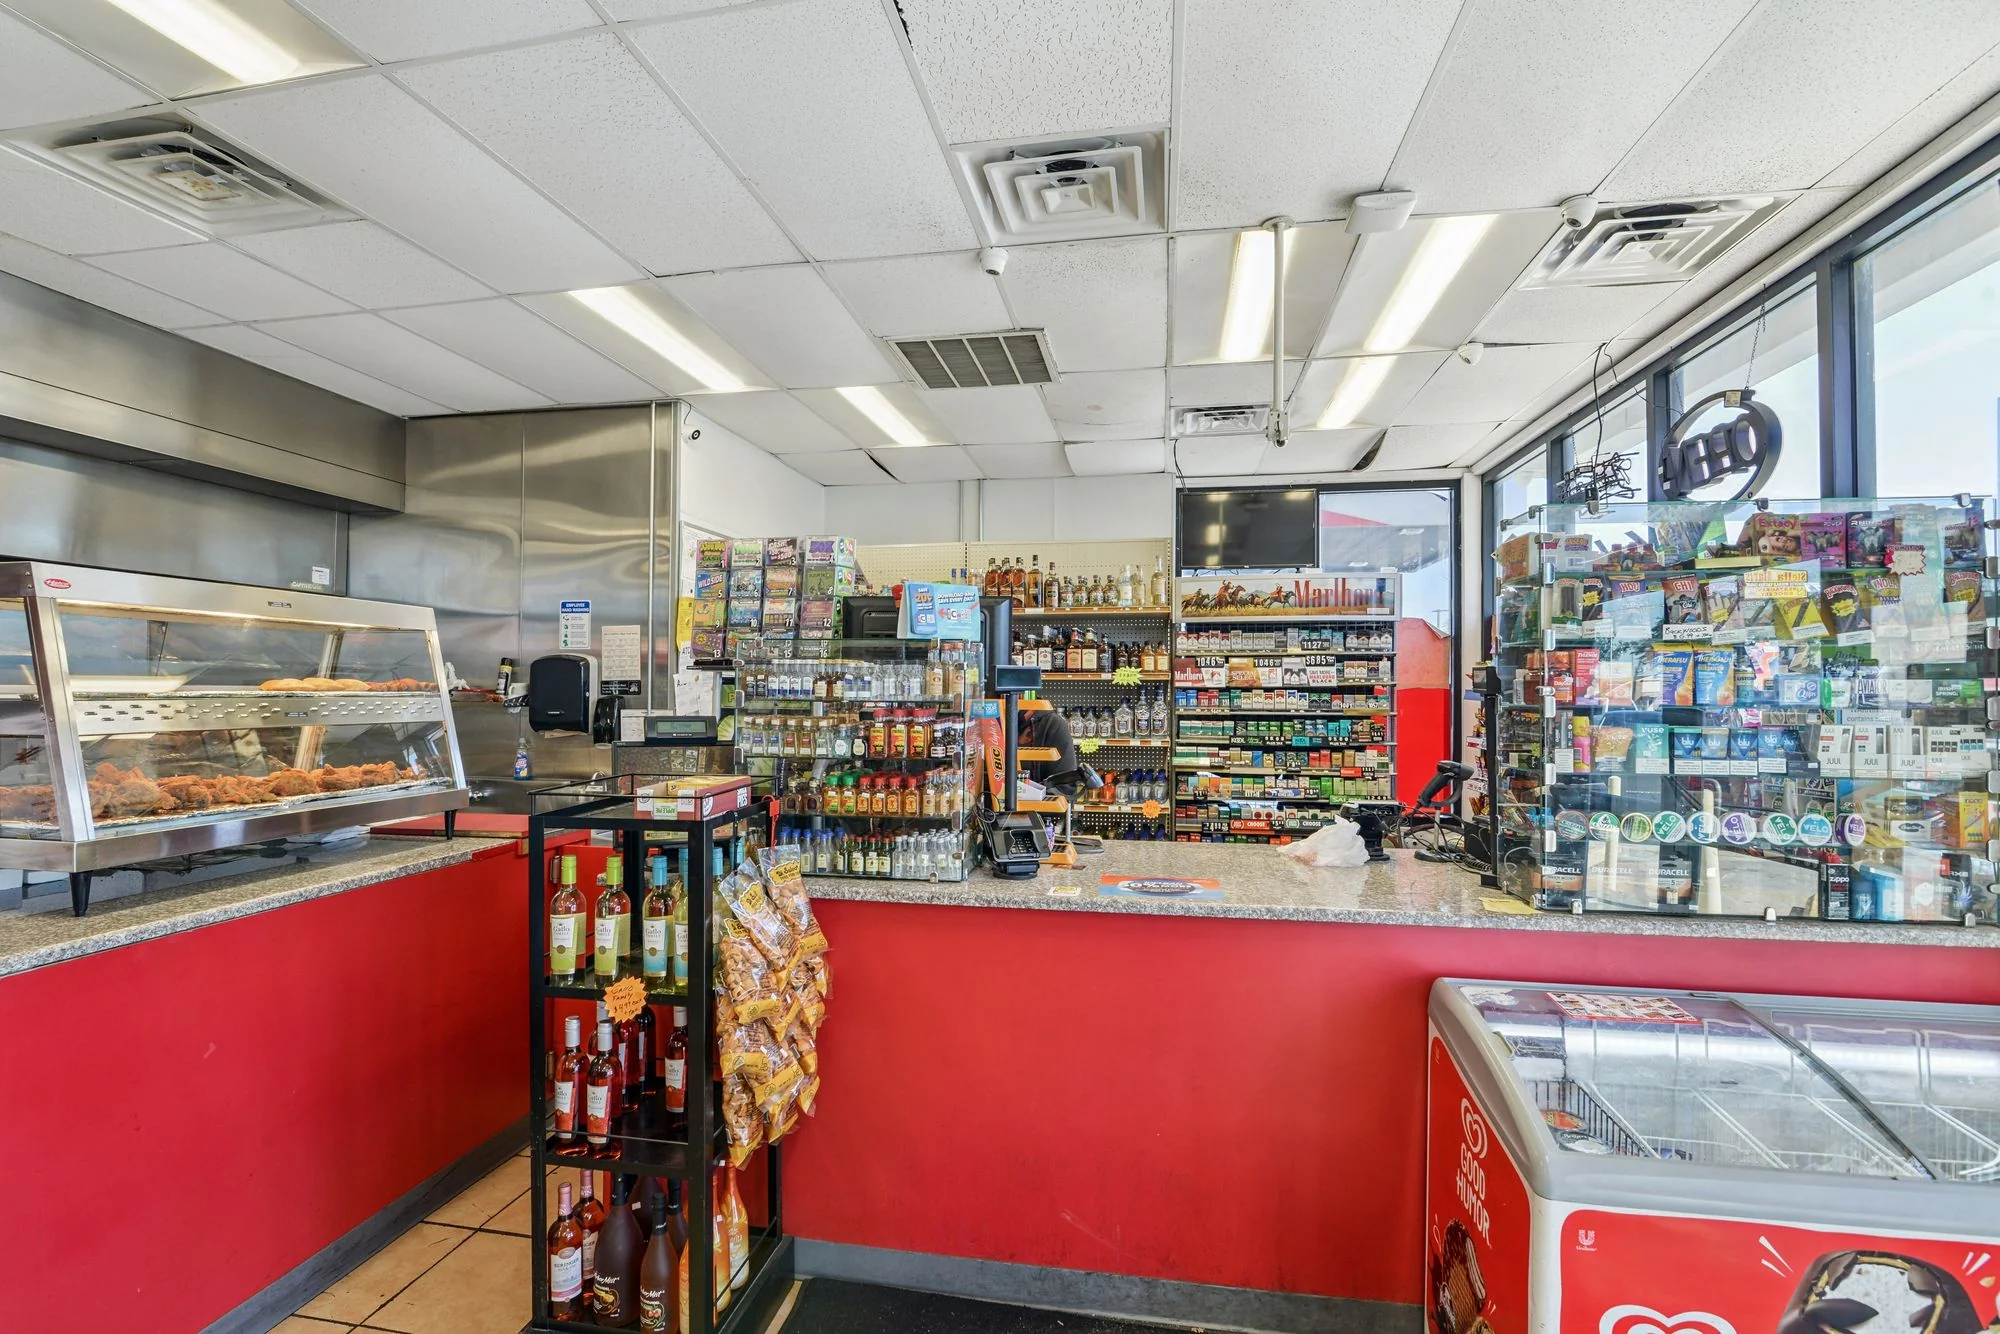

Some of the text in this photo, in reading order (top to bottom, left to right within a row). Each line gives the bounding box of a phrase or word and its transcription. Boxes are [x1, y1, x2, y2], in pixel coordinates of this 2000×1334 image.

[1759, 519, 1797, 529] Extacy
[1174, 667, 1203, 681] Marlboro
[1641, 726, 1665, 734] vuse
[1681, 734, 1695, 746] blu
[1707, 734, 1721, 746] blu
[1737, 734, 1751, 746] blu
[993, 748, 1003, 771] BIC
[1826, 757, 1842, 765] JUUL
[1657, 815, 1677, 836] VELO
[1730, 816, 1742, 841] VELO
[1775, 816, 1791, 840] VELO
[1803, 824, 1829, 832] VELO
[1849, 823, 1864, 832] VELO
[1460, 1142, 1486, 1201] GOOD
[1455, 1167, 1491, 1247] HUMOR
